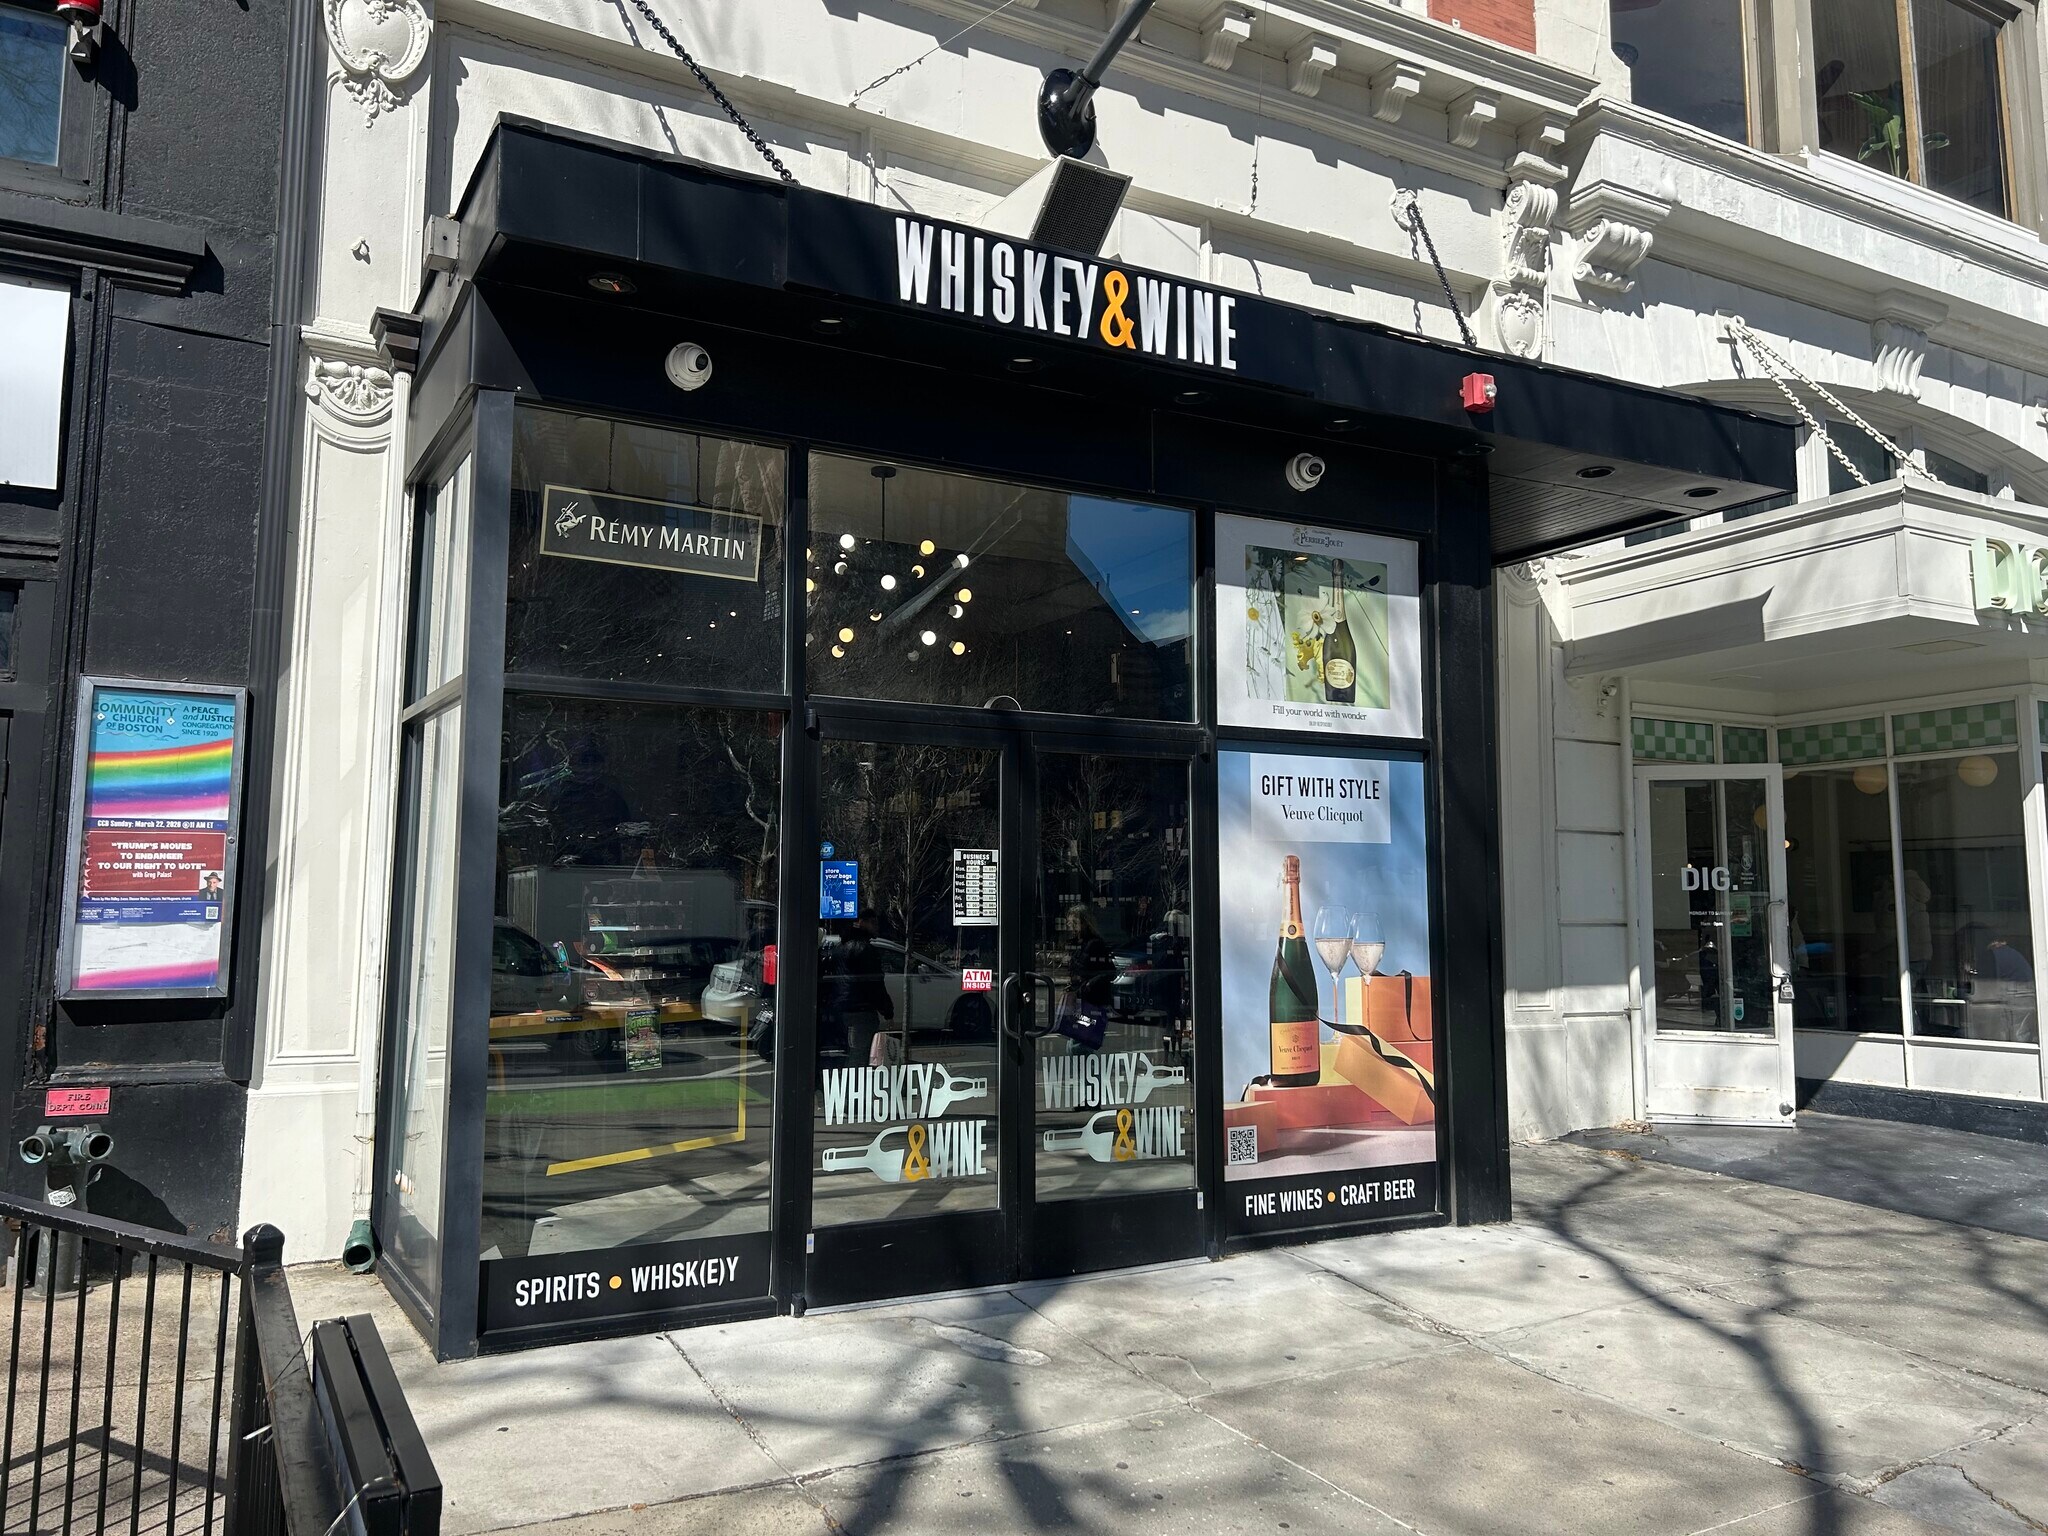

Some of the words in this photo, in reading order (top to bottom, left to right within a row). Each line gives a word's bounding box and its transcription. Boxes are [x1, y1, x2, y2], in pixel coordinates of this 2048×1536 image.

[590, 515, 654, 548] RÉMY
[658, 525, 746, 561] MARTIN
[112, 713, 160, 724] CHURCH
[191, 706, 220, 714] PEACE
[200, 714, 235, 723] JUSTICE
[1272, 704, 1284, 714] Fill
[1303, 709, 1323, 718] world
[1324, 710, 1340, 718] with
[1341, 712, 1367, 720] wonder
[106, 722, 116, 730] OF
[118, 723, 163, 734] BOSTON
[182, 722, 234, 730] CONGREGATION
[1262, 774, 1293, 796] GIFT
[1298, 776, 1334, 798] WITH
[1339, 778, 1380, 800] STYLE
[1281, 804, 1315, 820] Veuve
[1318, 806, 1364, 825] Clicquot
[1681, 866, 1738, 891] DIG.
[964, 971, 990, 980] ATM
[1042, 1052, 1138, 1109] WHISKEY
[68, 1093, 91, 1101] FIRE
[822, 1063, 934, 1126] WHISKEY
[48, 1104, 74, 1112] DEPT.
[1245, 1193, 1276, 1217] FINE
[1279, 1188, 1323, 1213] WINES
[1340, 1182, 1380, 1206] CRAFT
[1383, 1178, 1416, 1202] BEER
[630, 1256, 739, 1293] WHISK(E)Y
[515, 1272, 600, 1308] SPIRITS
